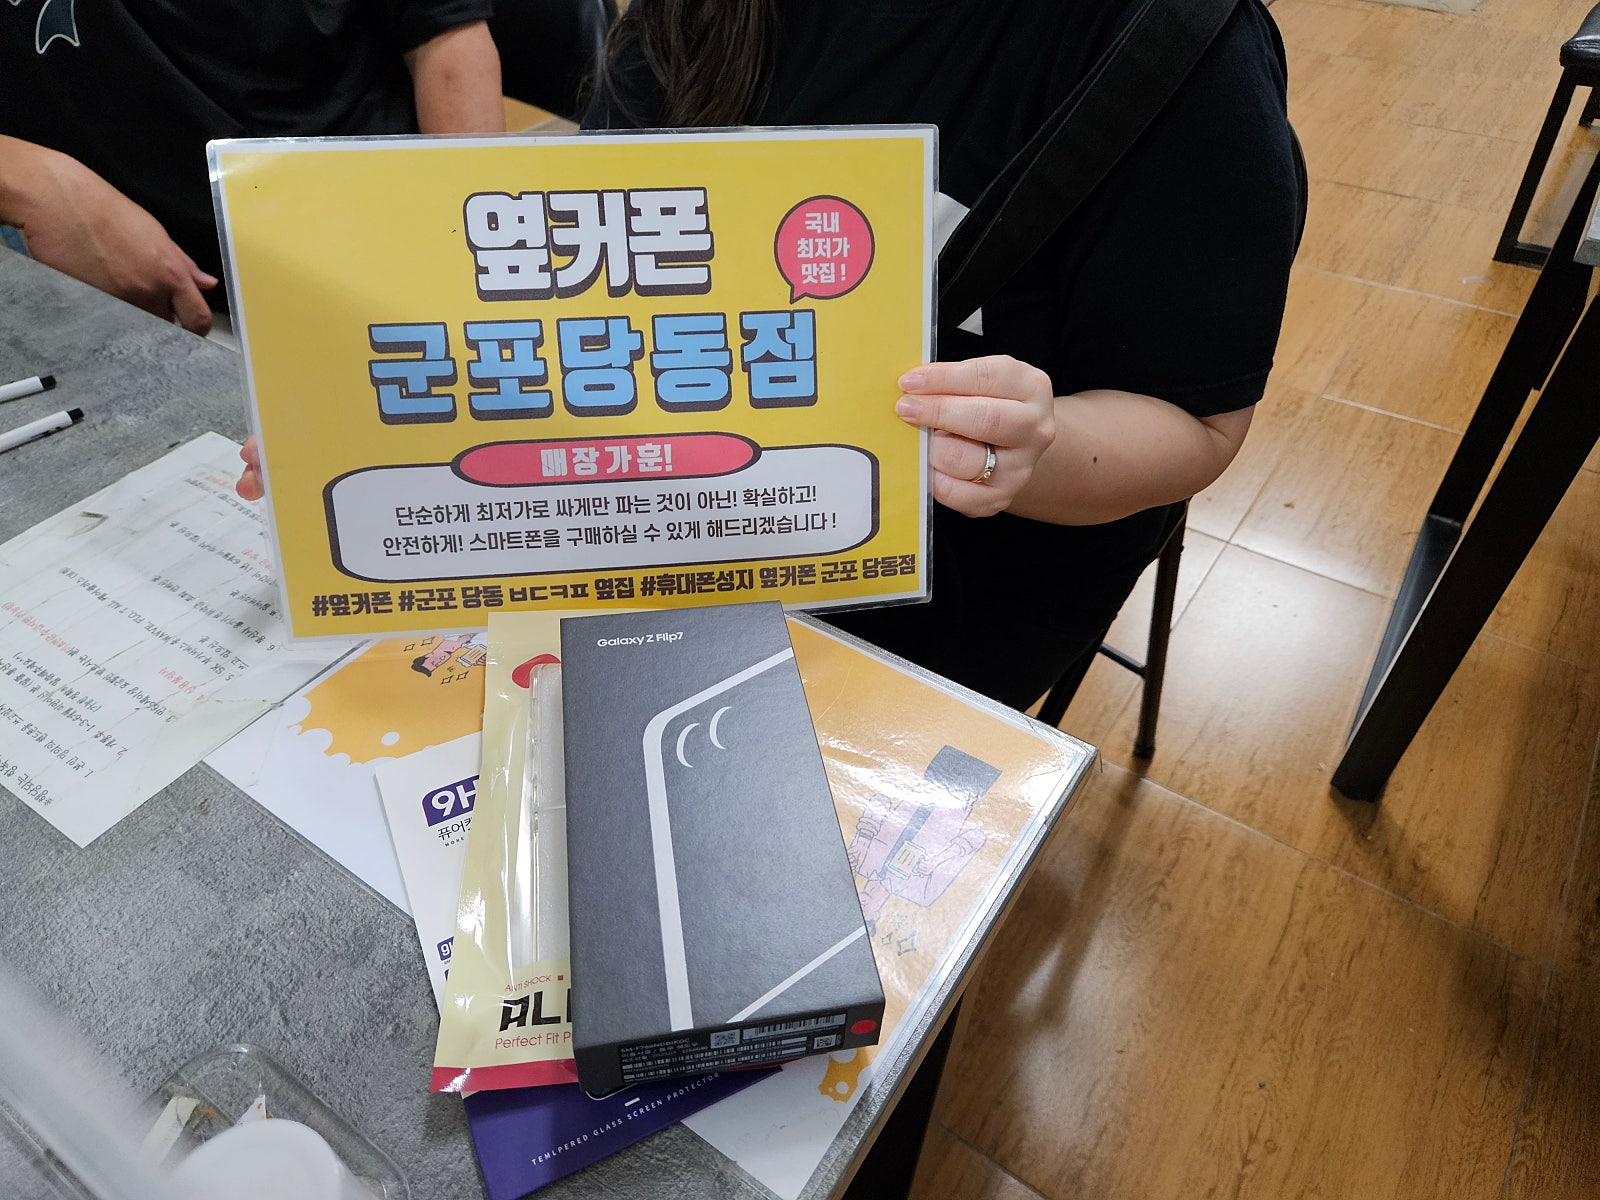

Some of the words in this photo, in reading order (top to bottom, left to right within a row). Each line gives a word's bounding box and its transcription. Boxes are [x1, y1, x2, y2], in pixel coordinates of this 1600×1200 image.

[805, 211, 840, 234] 국내
[463, 187, 714, 302] 옆커폰
[797, 237, 850, 259] 최저가
[801, 262, 836, 284] 맛집
[368, 309, 818, 425] 군포당동점
[395, 503, 470, 526] 단순하게
[476, 500, 550, 522] 최저가로
[555, 496, 610, 518] 싸게만
[615, 494, 651, 514] 파는
[656, 492, 691, 513] 것이
[697, 490, 738, 510] 아닌!
[742, 486, 818, 508] 확실하고!
[382, 534, 464, 557] 안전하게!
[469, 528, 561, 552] 스마트폰을
[566, 523, 638, 547] 구매하실
[643, 523, 661, 542] 수
[666, 520, 701, 541] 있게
[706, 512, 828, 538] 해드리겠습니다
[312, 591, 393, 617] #옆커폰
[398, 588, 458, 611] #군포
[461, 585, 504, 609] 당동
[594, 576, 635, 600] 옆집
[640, 568, 754, 597] #휴대폰성지
[759, 563, 817, 589] 옆커폰
[820, 560, 859, 583] 군포
[862, 554, 916, 578] 당동점
[241, 627, 266, 643] 통신사
[597, 636, 645, 647] Galaxy
[646, 634, 654, 643] Z
[656, 631, 684, 643] Flip7
[210, 663, 225, 676] SK
[524, 975, 552, 990] SHOCK
[495, 1033, 543, 1049] Perfect
[546, 1031, 559, 1044] Fit
[531, 1133, 590, 1166] TEMLPERED
[593, 1117, 624, 1137] GLASS
[627, 1099, 664, 1121] SCREEN
[667, 1071, 720, 1101] PROTECTOR
